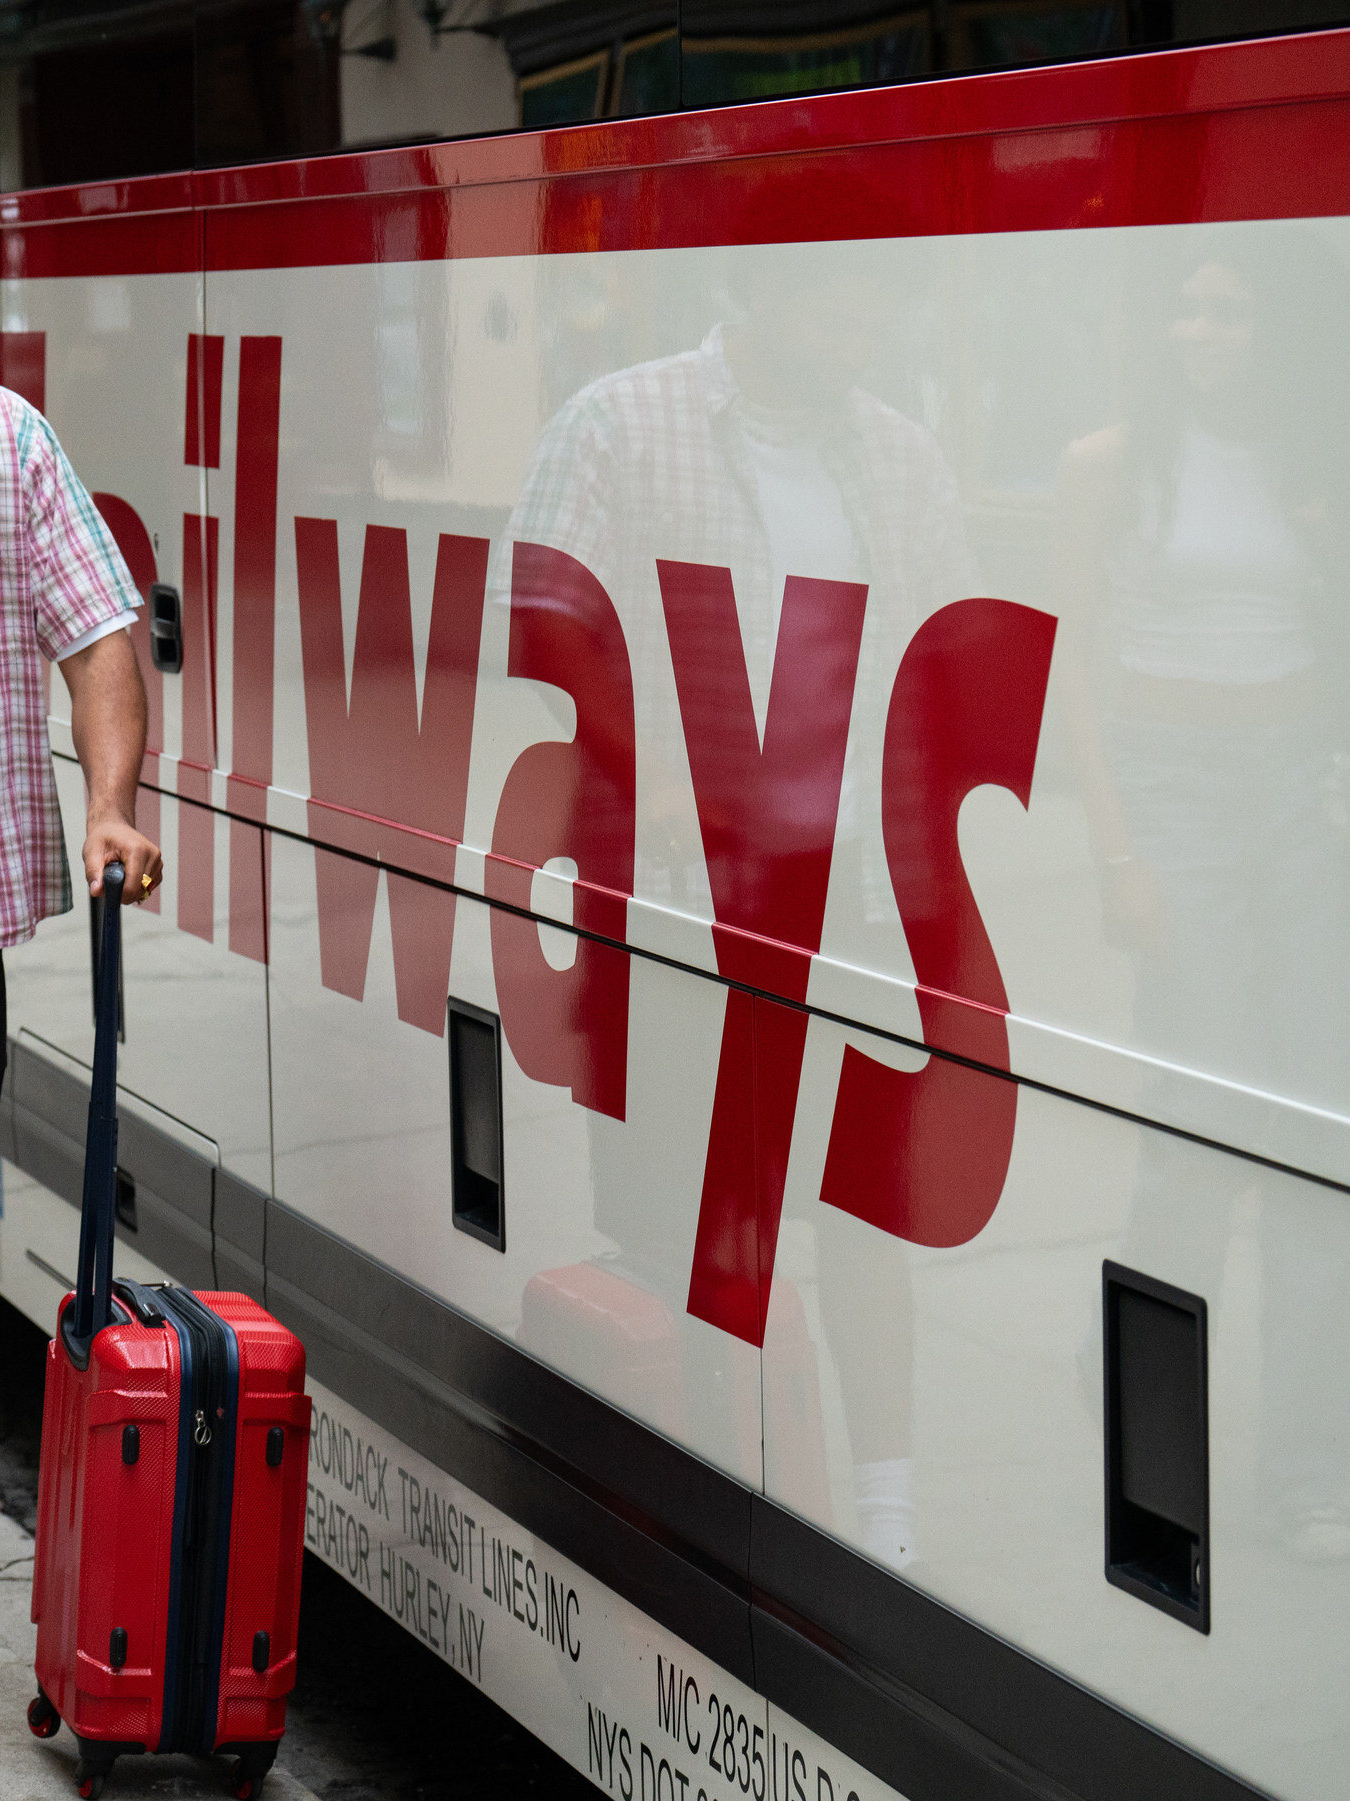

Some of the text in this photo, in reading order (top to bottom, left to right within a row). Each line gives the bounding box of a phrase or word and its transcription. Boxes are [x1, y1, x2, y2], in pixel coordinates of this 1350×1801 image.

[305, 1481, 372, 1592] ERATOR
[309, 1403, 390, 1522] RONDACK
[397, 1466, 476, 1585] TRANSIT
[588, 1701, 633, 1801] NYS
[657, 1653, 701, 1755] M/C
[708, 1693, 766, 1801] 2835
